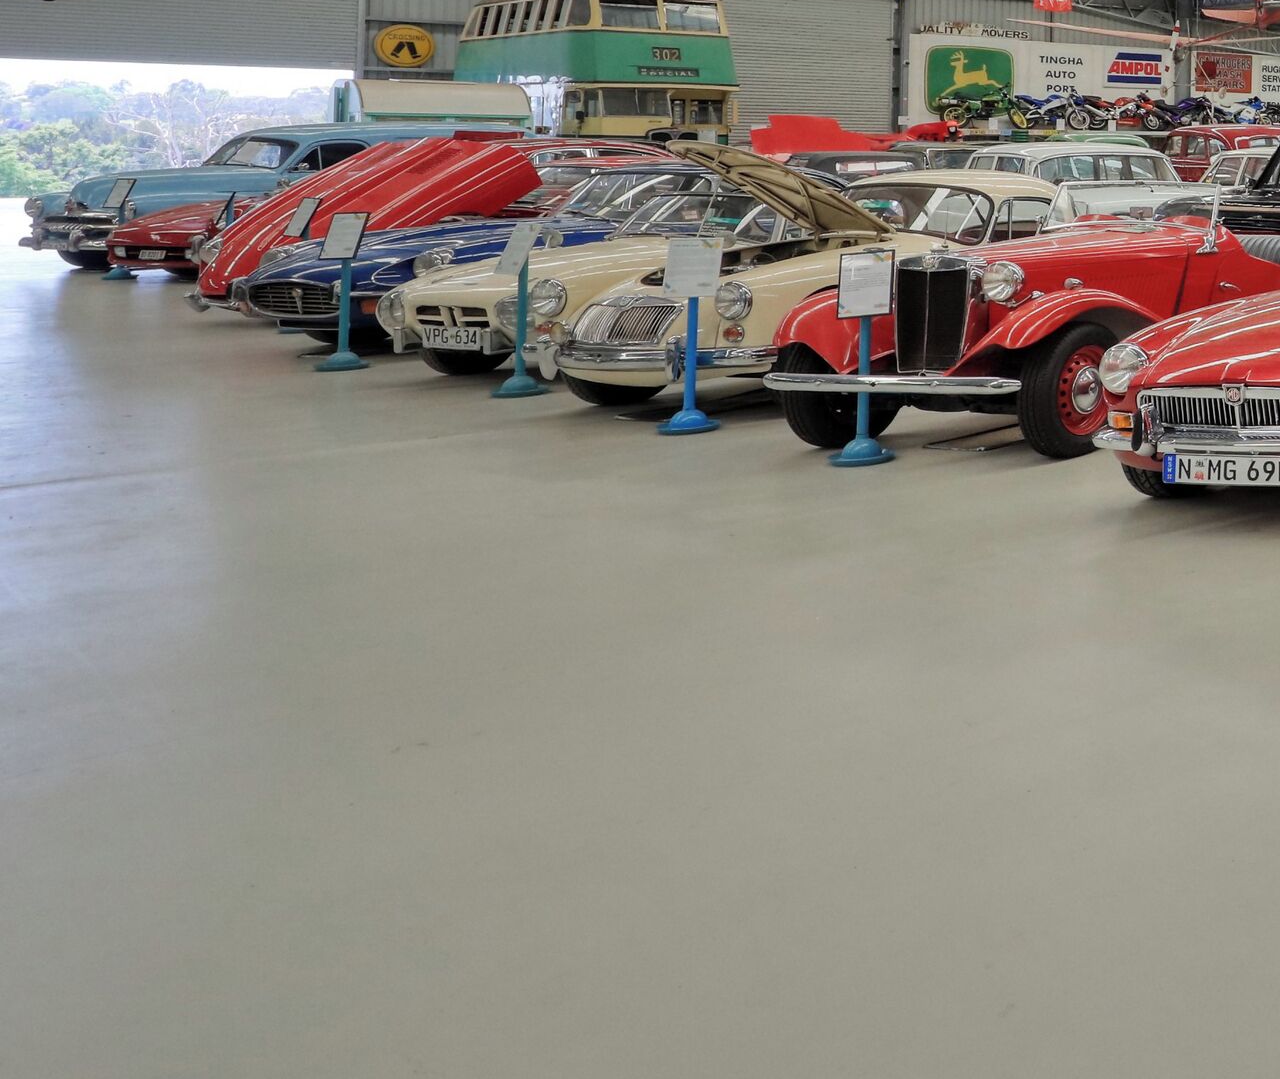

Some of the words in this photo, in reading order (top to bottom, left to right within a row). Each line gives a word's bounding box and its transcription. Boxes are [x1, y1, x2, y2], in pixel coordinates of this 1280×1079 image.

[981, 28, 1029, 39] MOWERS
[653, 49, 680, 61] 302
[1039, 55, 1084, 66] TINGHA
[1107, 61, 1162, 76] AMPOL
[1045, 70, 1076, 79] AUTO
[1046, 84, 1076, 93] PORT
[424, 327, 449, 344] VPG
[455, 329, 477, 345] 634
[1178, 458, 1192, 480] N
[1207, 459, 1237, 481] MG
